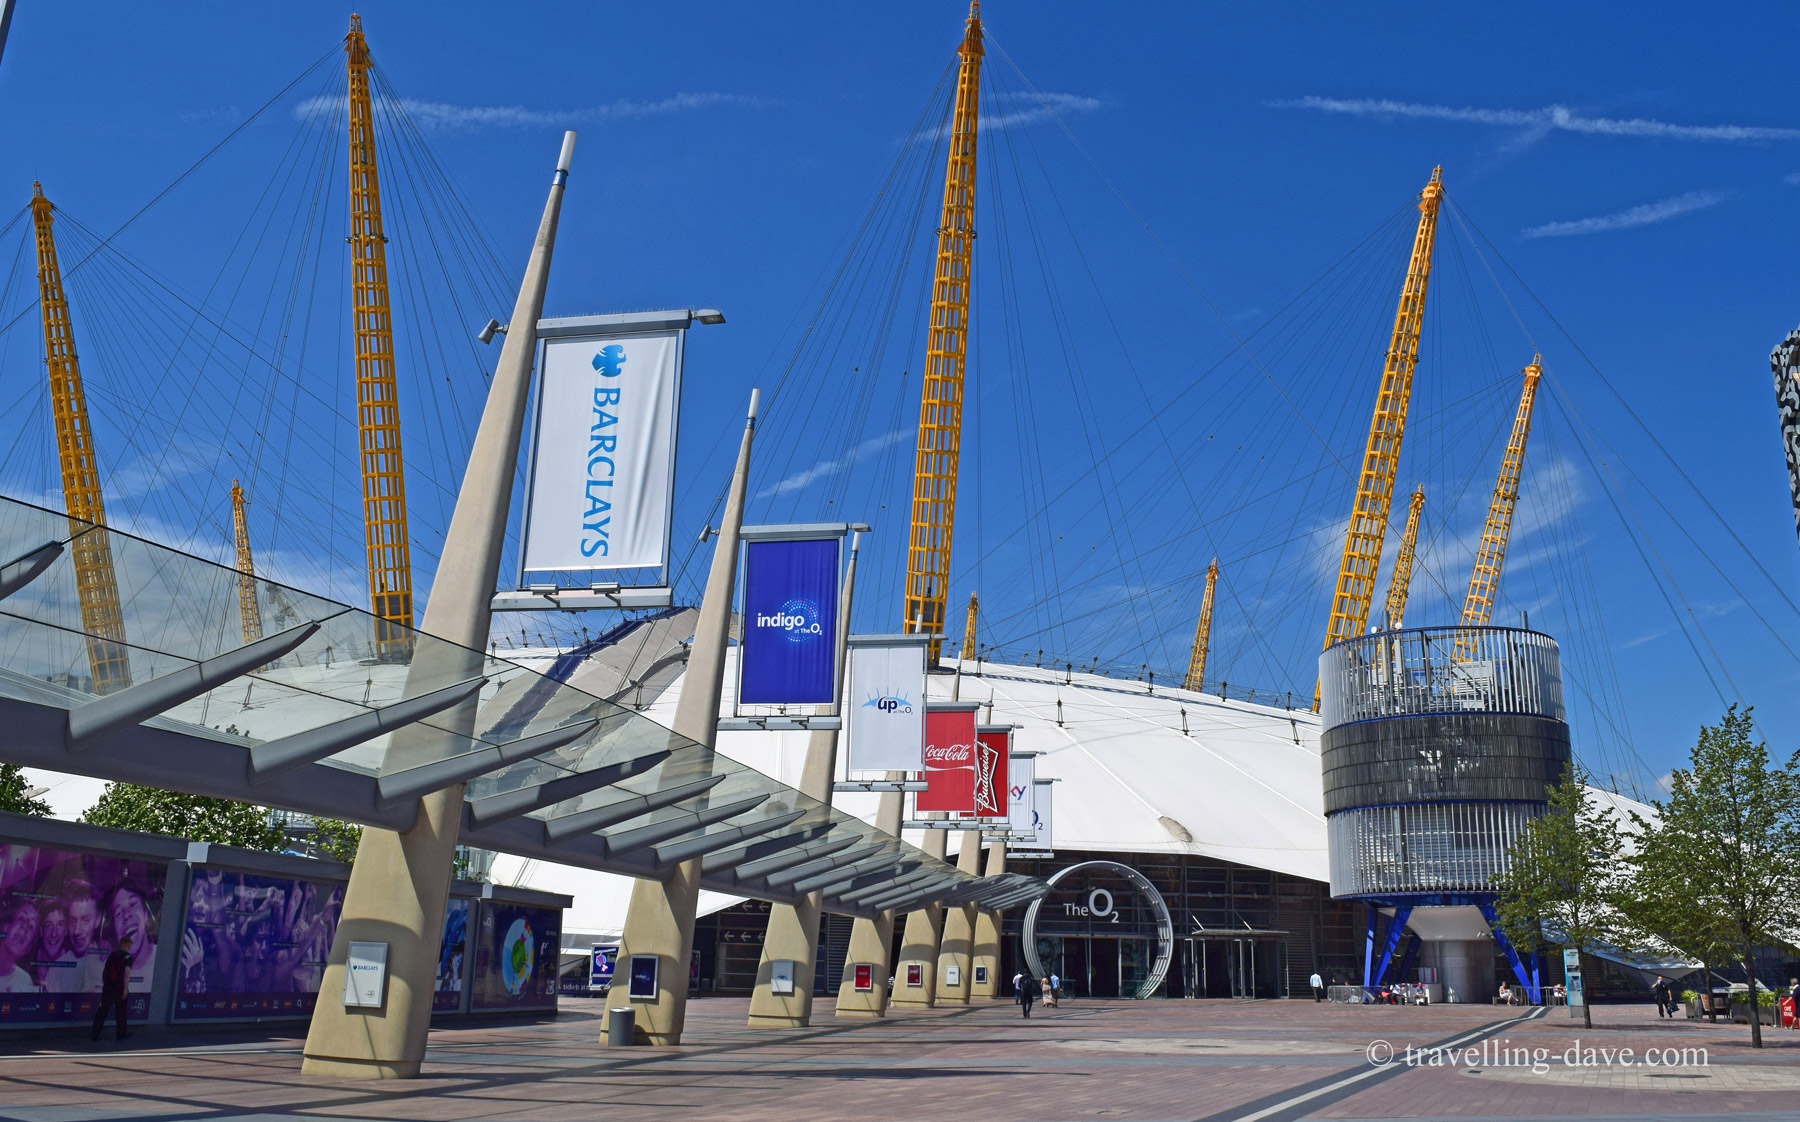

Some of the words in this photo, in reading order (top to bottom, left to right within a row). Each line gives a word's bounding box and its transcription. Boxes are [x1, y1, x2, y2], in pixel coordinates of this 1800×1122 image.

[580, 387, 621, 558] BARCLAYS
[757, 612, 805, 631] indigo
[877, 695, 898, 714] up
[925, 744, 971, 761] Coca-Cola
[977, 741, 990, 811] Budweiser
[1063, 902, 1089, 917] The
